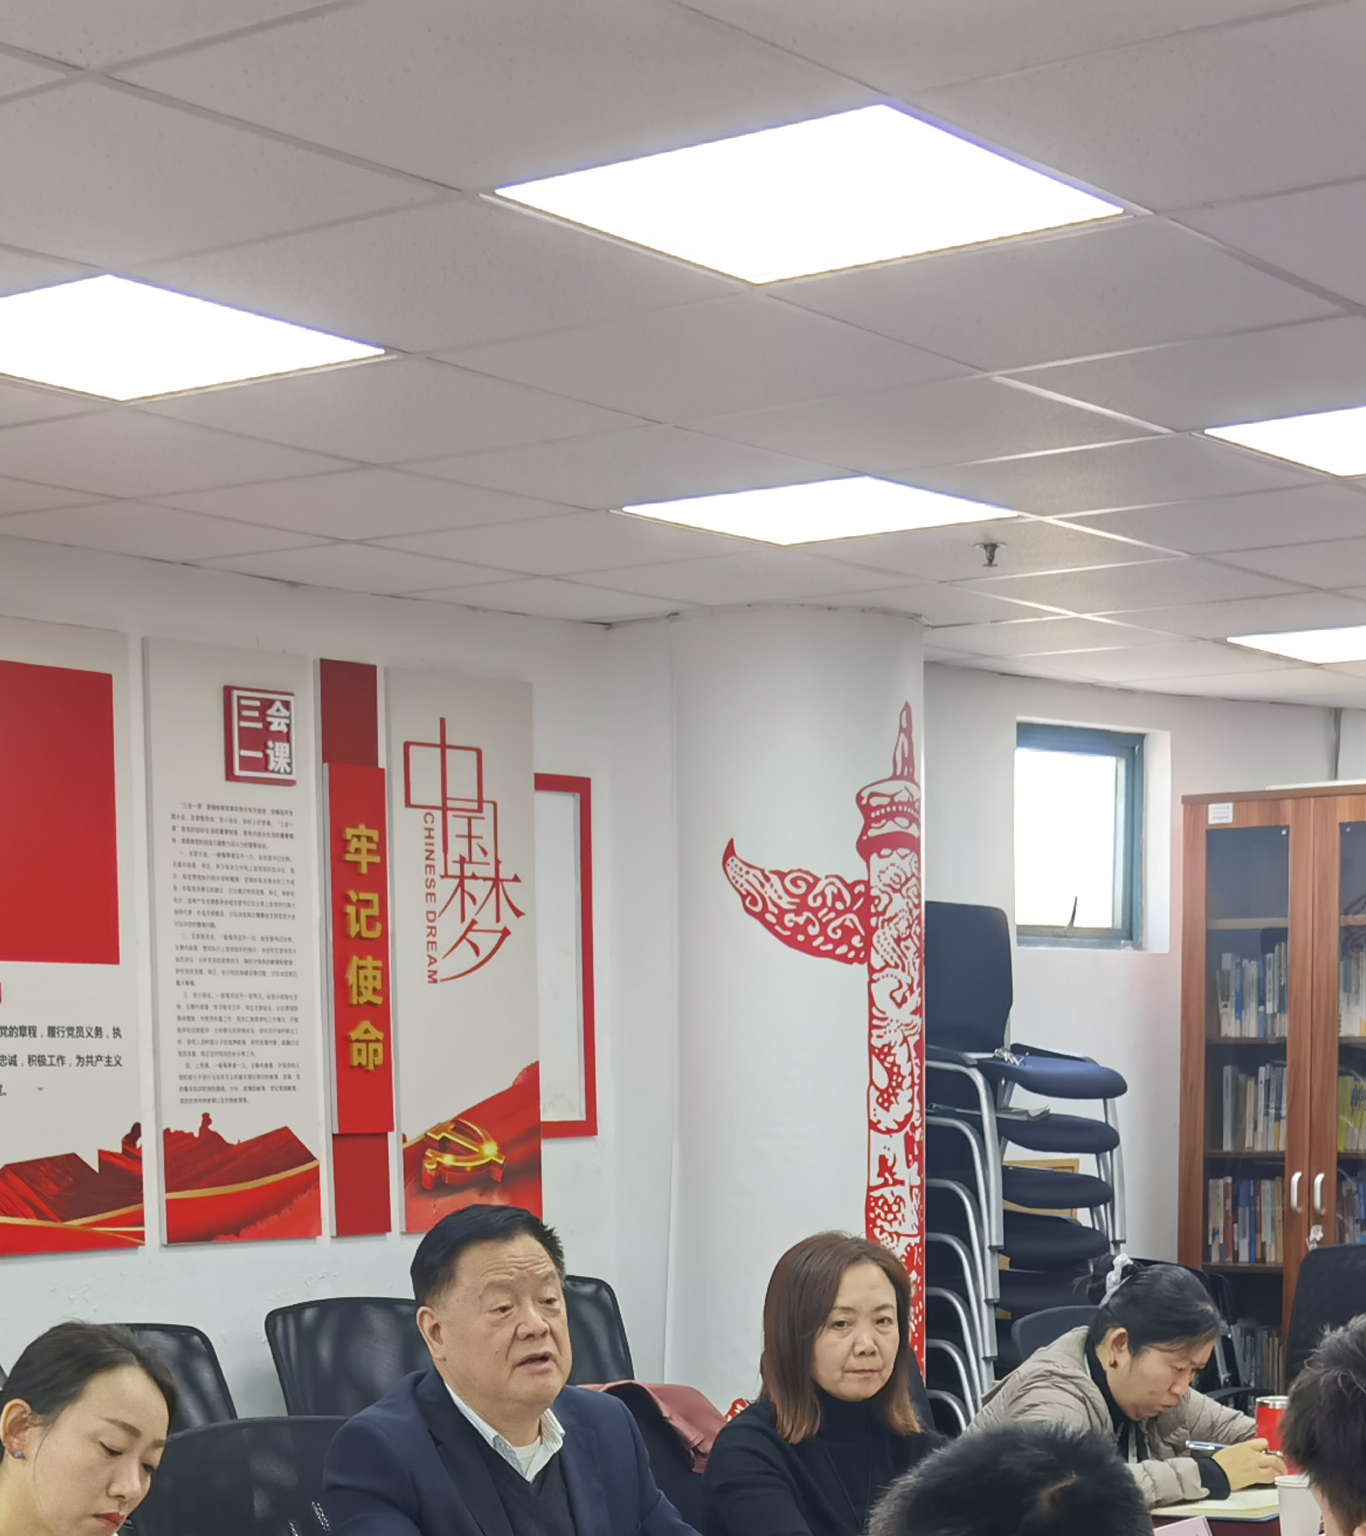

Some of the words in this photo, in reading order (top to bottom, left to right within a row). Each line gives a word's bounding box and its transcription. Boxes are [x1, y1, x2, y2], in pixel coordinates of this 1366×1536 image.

[239, 700, 290, 733] 三会
[239, 740, 291, 773] 一课
[403, 717, 525, 982] 中国梦
[423, 812, 436, 903] CHINESE
[343, 823, 384, 1071] 牢记使命
[426, 910, 439, 984] DREAM
